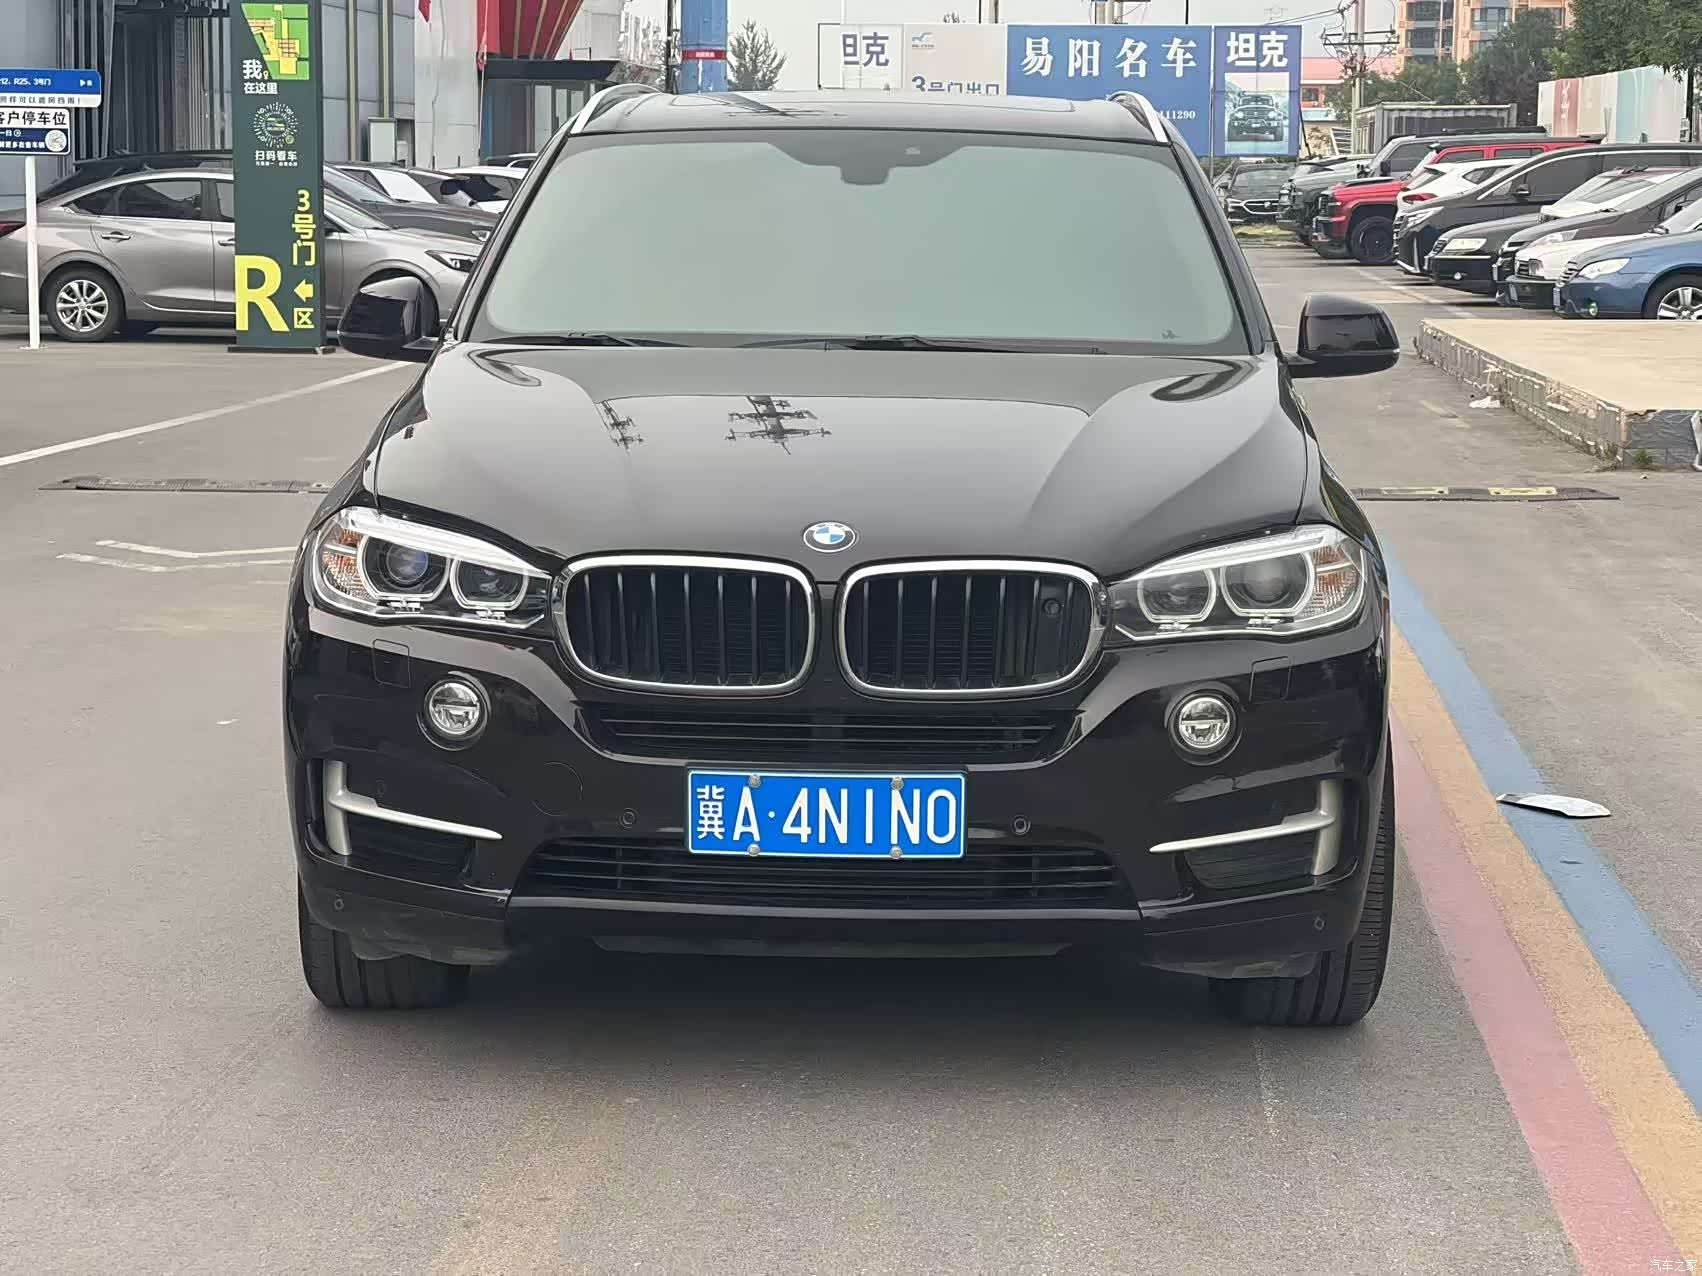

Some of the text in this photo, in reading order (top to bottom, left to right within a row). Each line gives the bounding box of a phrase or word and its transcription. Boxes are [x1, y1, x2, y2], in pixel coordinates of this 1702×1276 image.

[1020, 36, 1197, 78] 易阳名车
[1226, 30, 1289, 68] 坦克
[242, 59, 263, 79] 我
[243, 82, 278, 94] 在这里
[255, 150, 298, 161] 扫码看车
[292, 189, 316, 266] 3号门
[234, 255, 315, 332] R 区
